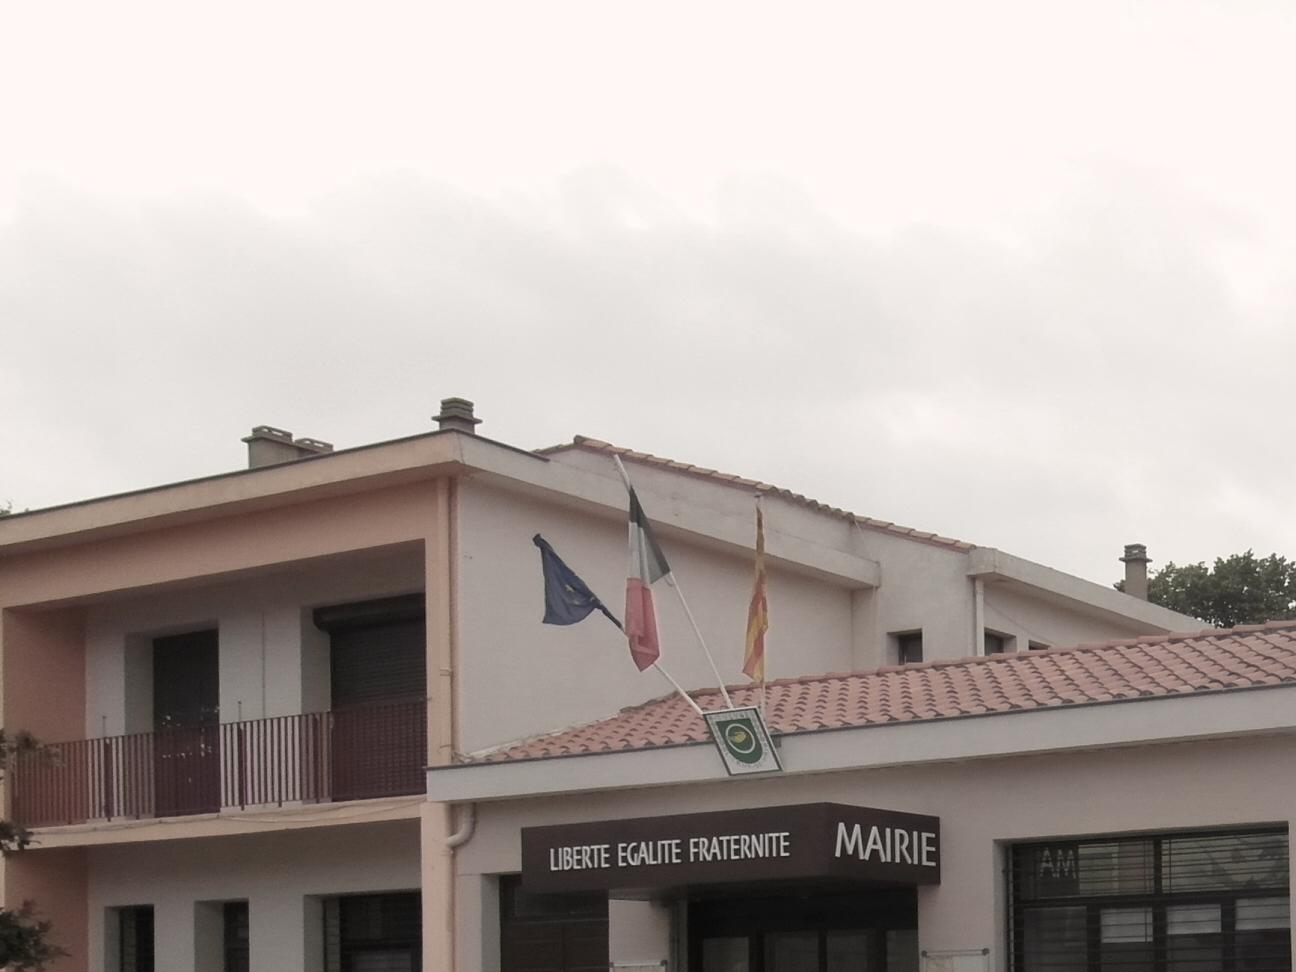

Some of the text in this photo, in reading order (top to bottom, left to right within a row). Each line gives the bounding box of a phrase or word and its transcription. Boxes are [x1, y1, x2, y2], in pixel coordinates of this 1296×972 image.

[549, 831, 791, 871] LIBERTE EGALITE FRATERNITE
[834, 821, 937, 866] MAIRIE
